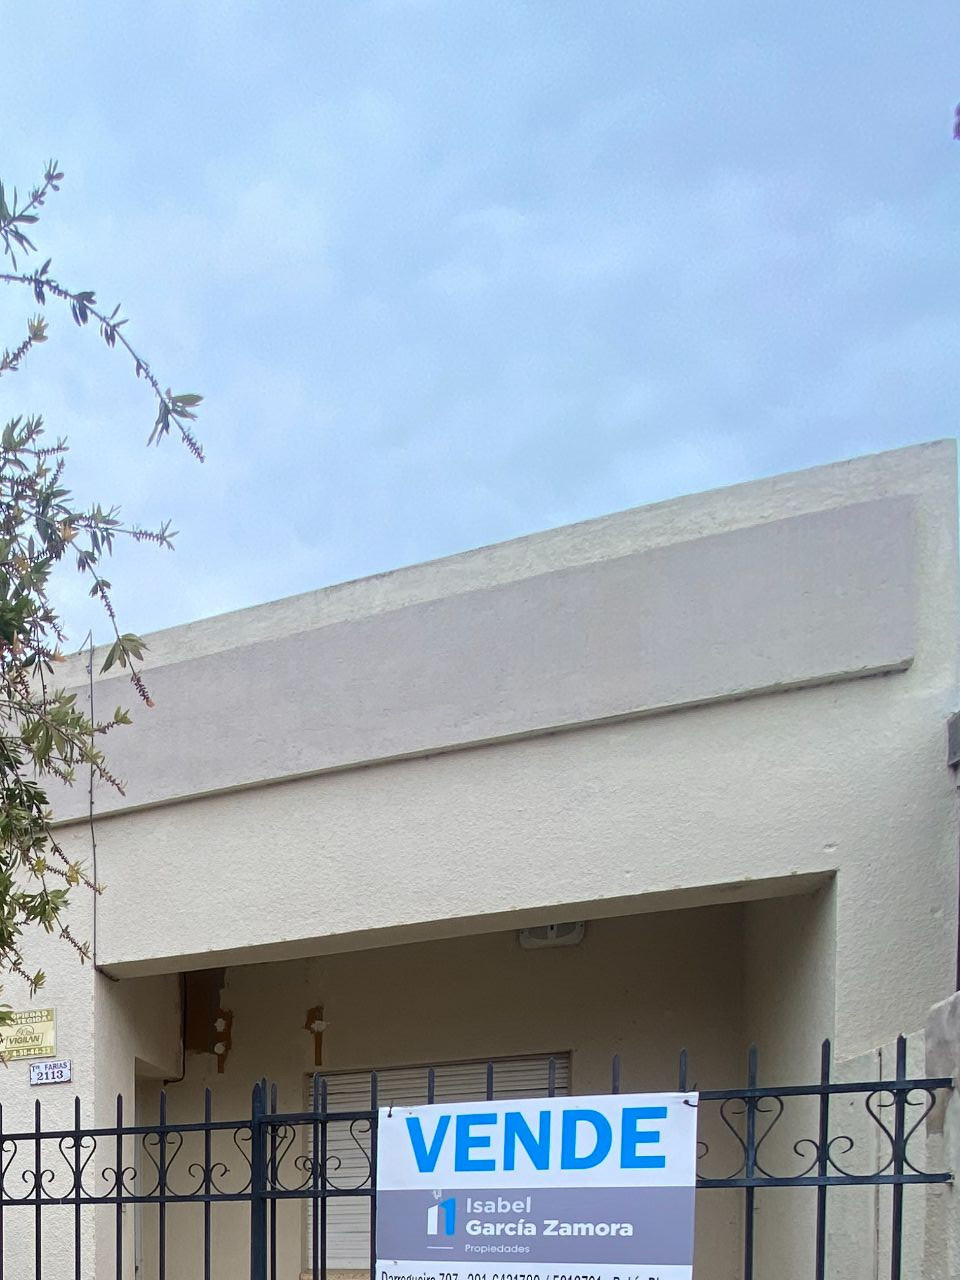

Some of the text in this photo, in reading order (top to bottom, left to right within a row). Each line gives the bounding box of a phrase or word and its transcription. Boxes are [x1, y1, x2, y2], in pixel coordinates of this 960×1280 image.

[9, 1035, 40, 1045] VIGILAN
[44, 1062, 68, 1070] FARIAS
[37, 1070, 64, 1081] 2113
[405, 1106, 668, 1173] VENDE
[466, 1196, 531, 1213] Isabel
[465, 1218, 633, 1237] García Zamora
[464, 1243, 530, 1254] Propiedades
